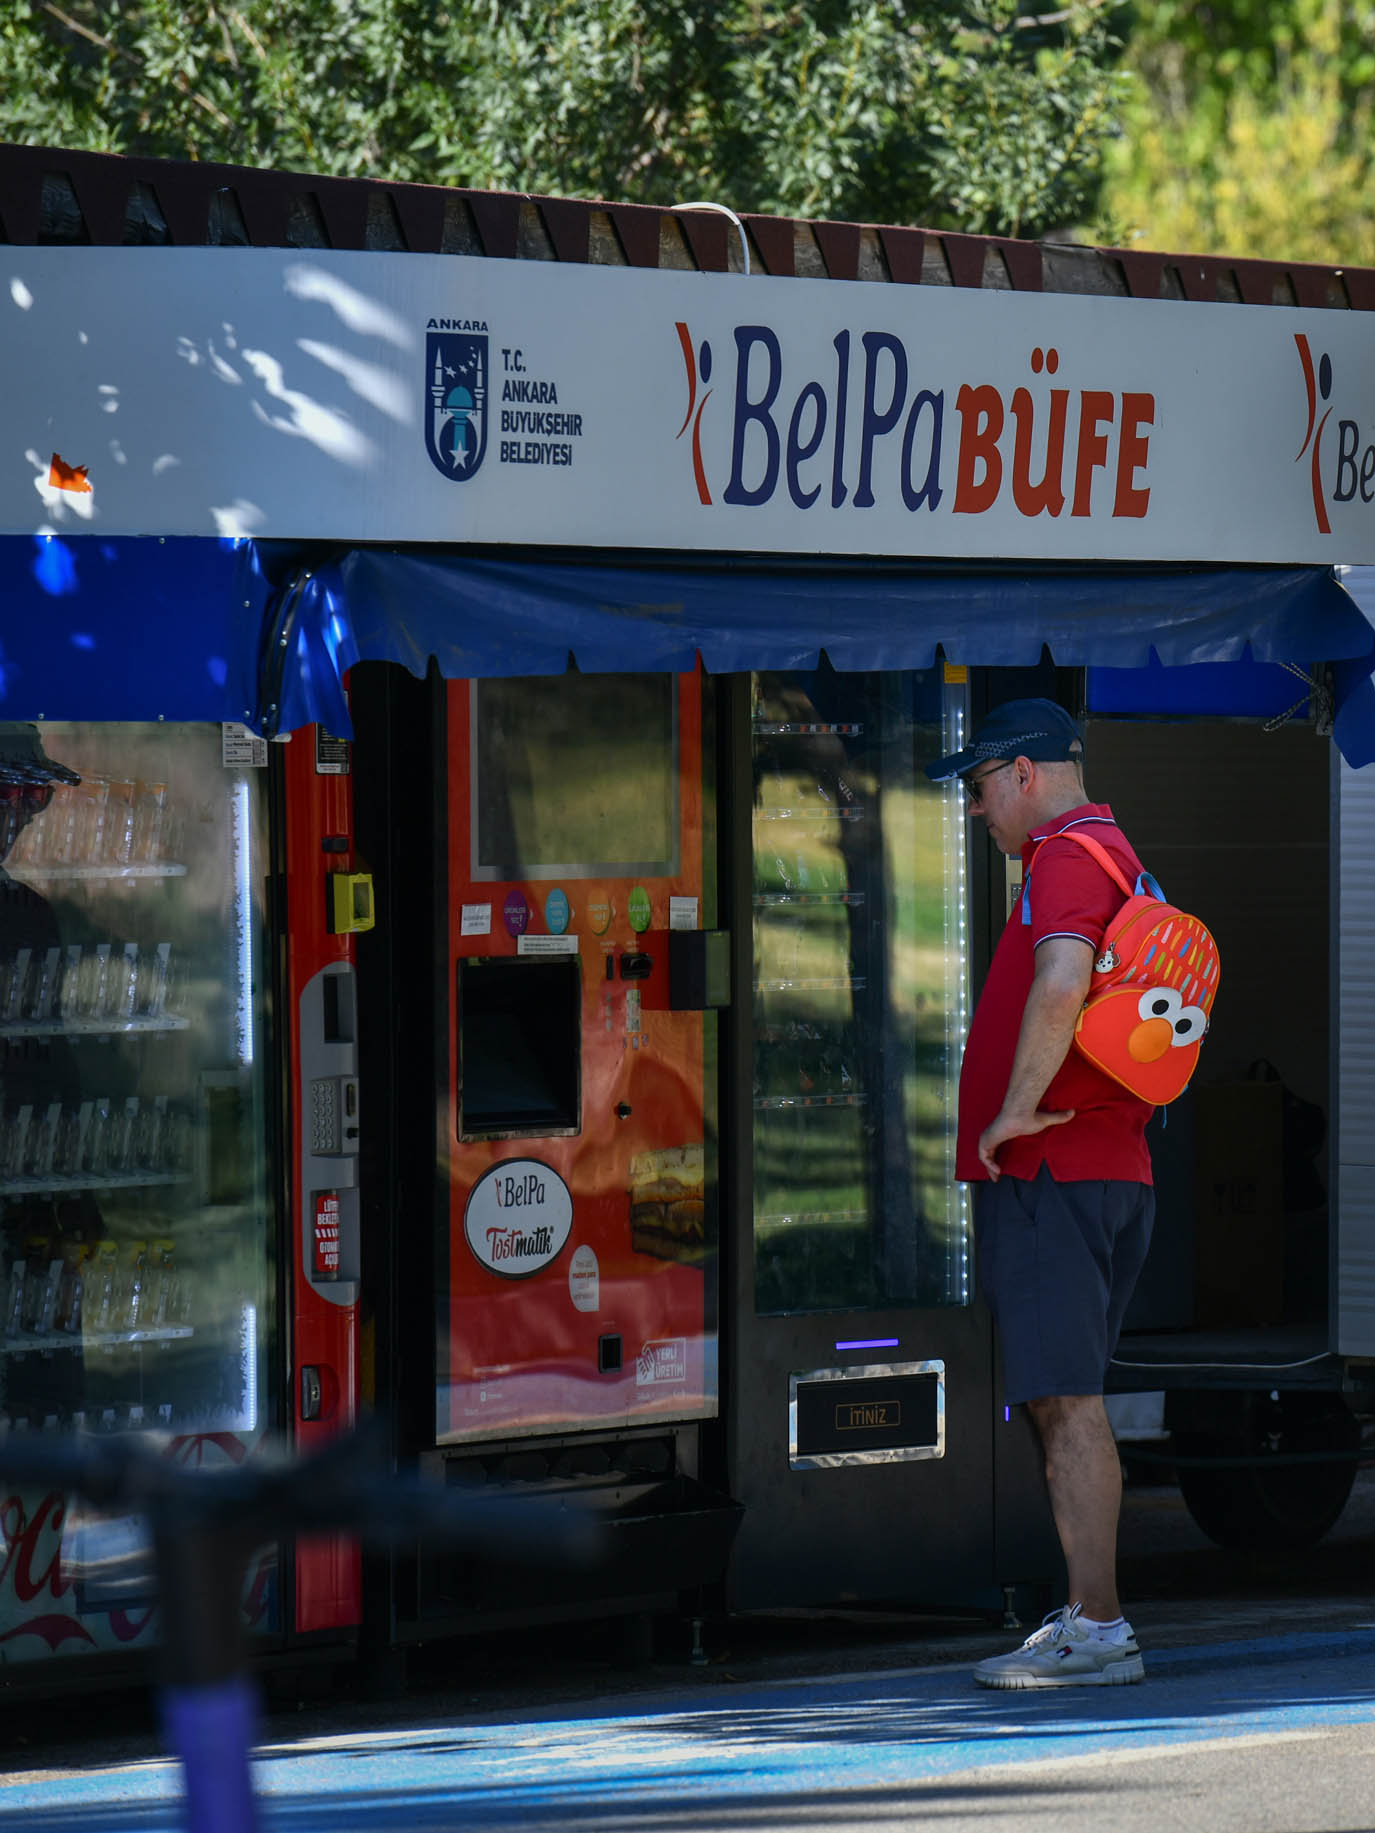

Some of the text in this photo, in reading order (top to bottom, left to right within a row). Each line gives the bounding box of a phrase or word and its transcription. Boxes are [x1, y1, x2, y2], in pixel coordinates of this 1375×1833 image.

[427, 318, 489, 332] ANKARA
[501, 349, 527, 372] T.C.
[502, 379, 558, 405] ANKARA
[500, 441, 573, 466] BELEDİYESİ
[504, 1175, 545, 1208] BelPa
